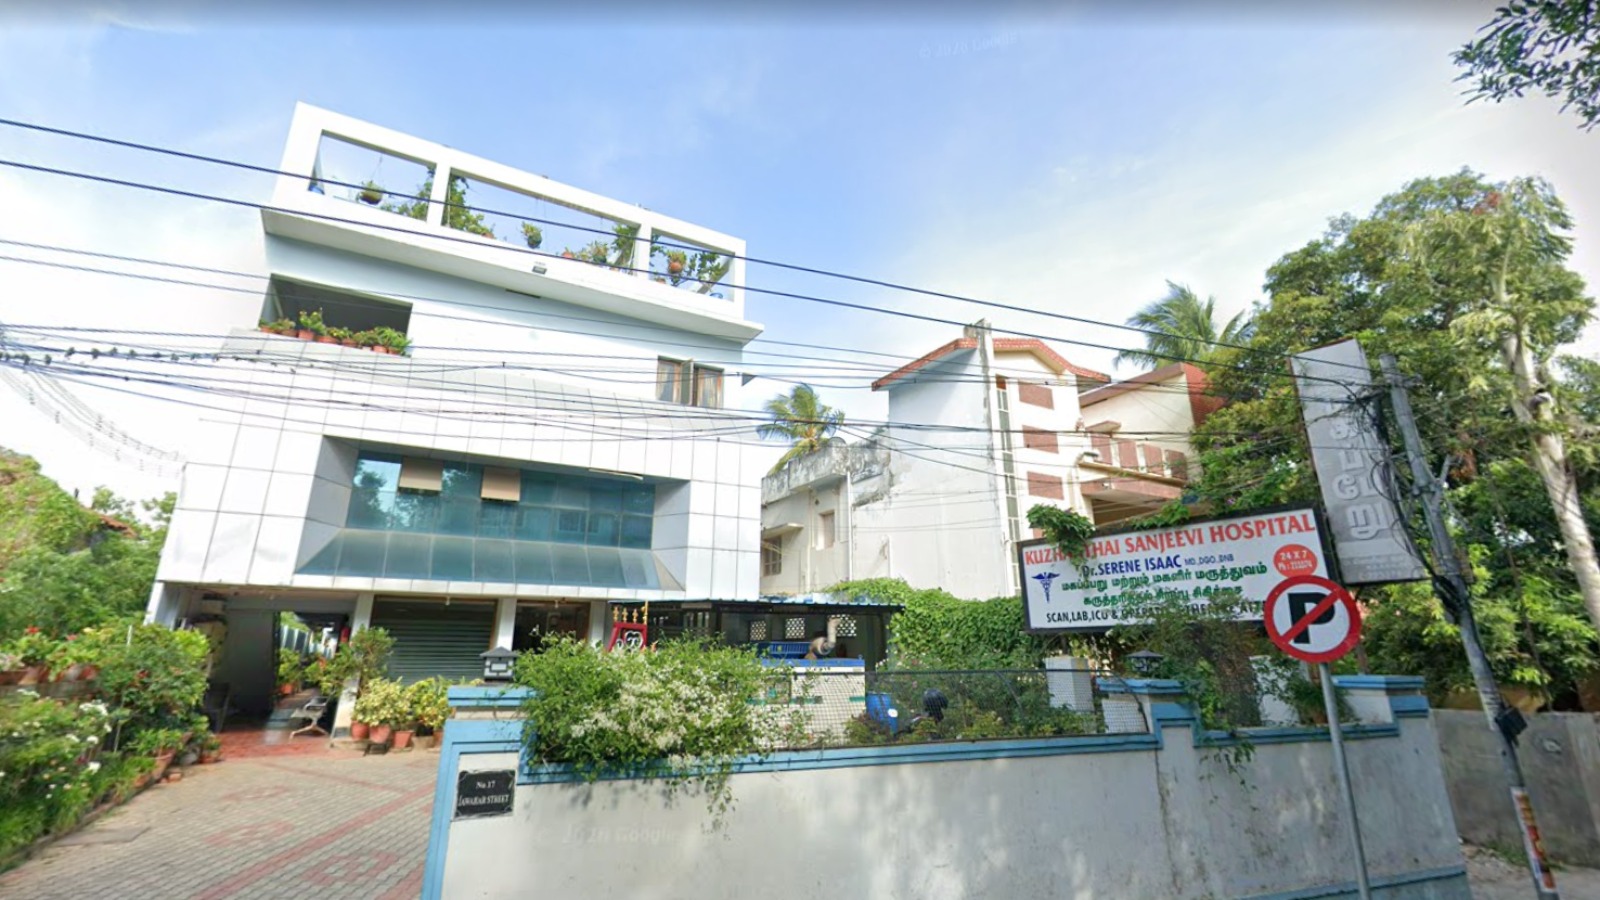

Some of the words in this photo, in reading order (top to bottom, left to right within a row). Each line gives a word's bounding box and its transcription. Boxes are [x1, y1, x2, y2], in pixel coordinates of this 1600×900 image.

[1125, 528, 1204, 553] SANJEEVI
[1209, 513, 1316, 544] HOSPITAL
[1144, 553, 1182, 571] ISAAC
[1279, 552, 1291, 561] 24
[1301, 549, 1308, 559] 7
[1195, 561, 1268, 582] மருத்துவம்
[1111, 609, 1119, 619] &
